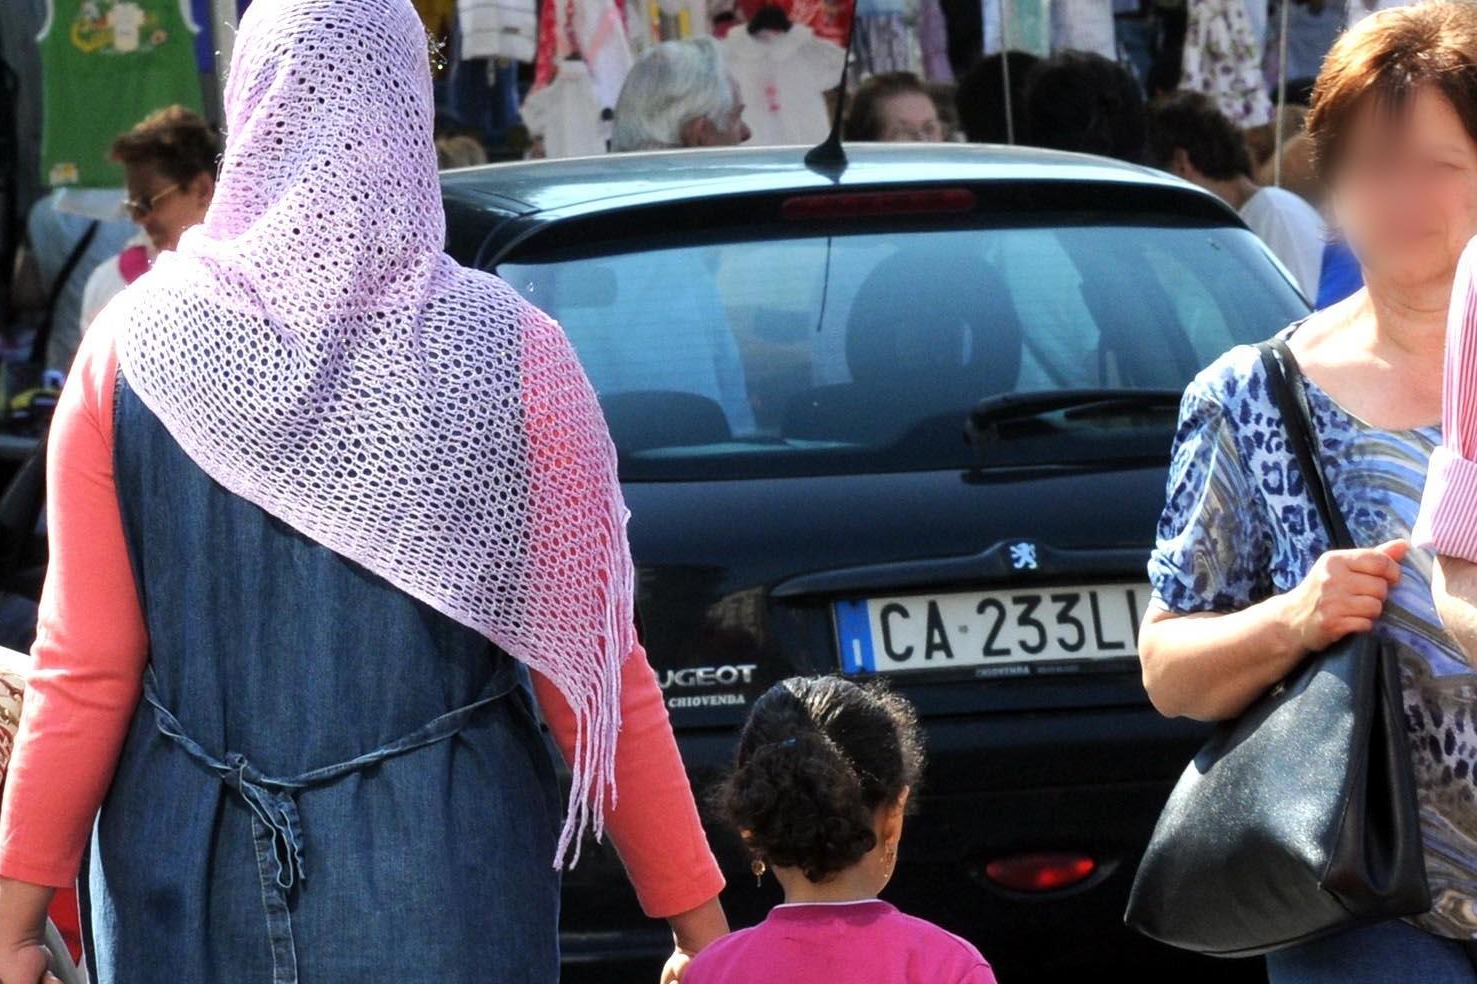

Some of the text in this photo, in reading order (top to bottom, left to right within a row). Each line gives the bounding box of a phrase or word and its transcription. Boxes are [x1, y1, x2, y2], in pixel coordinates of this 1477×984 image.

[879, 600, 954, 662] CA
[655, 664, 757, 689] UGEOT
[668, 694, 746, 708] CHIOVENDA
